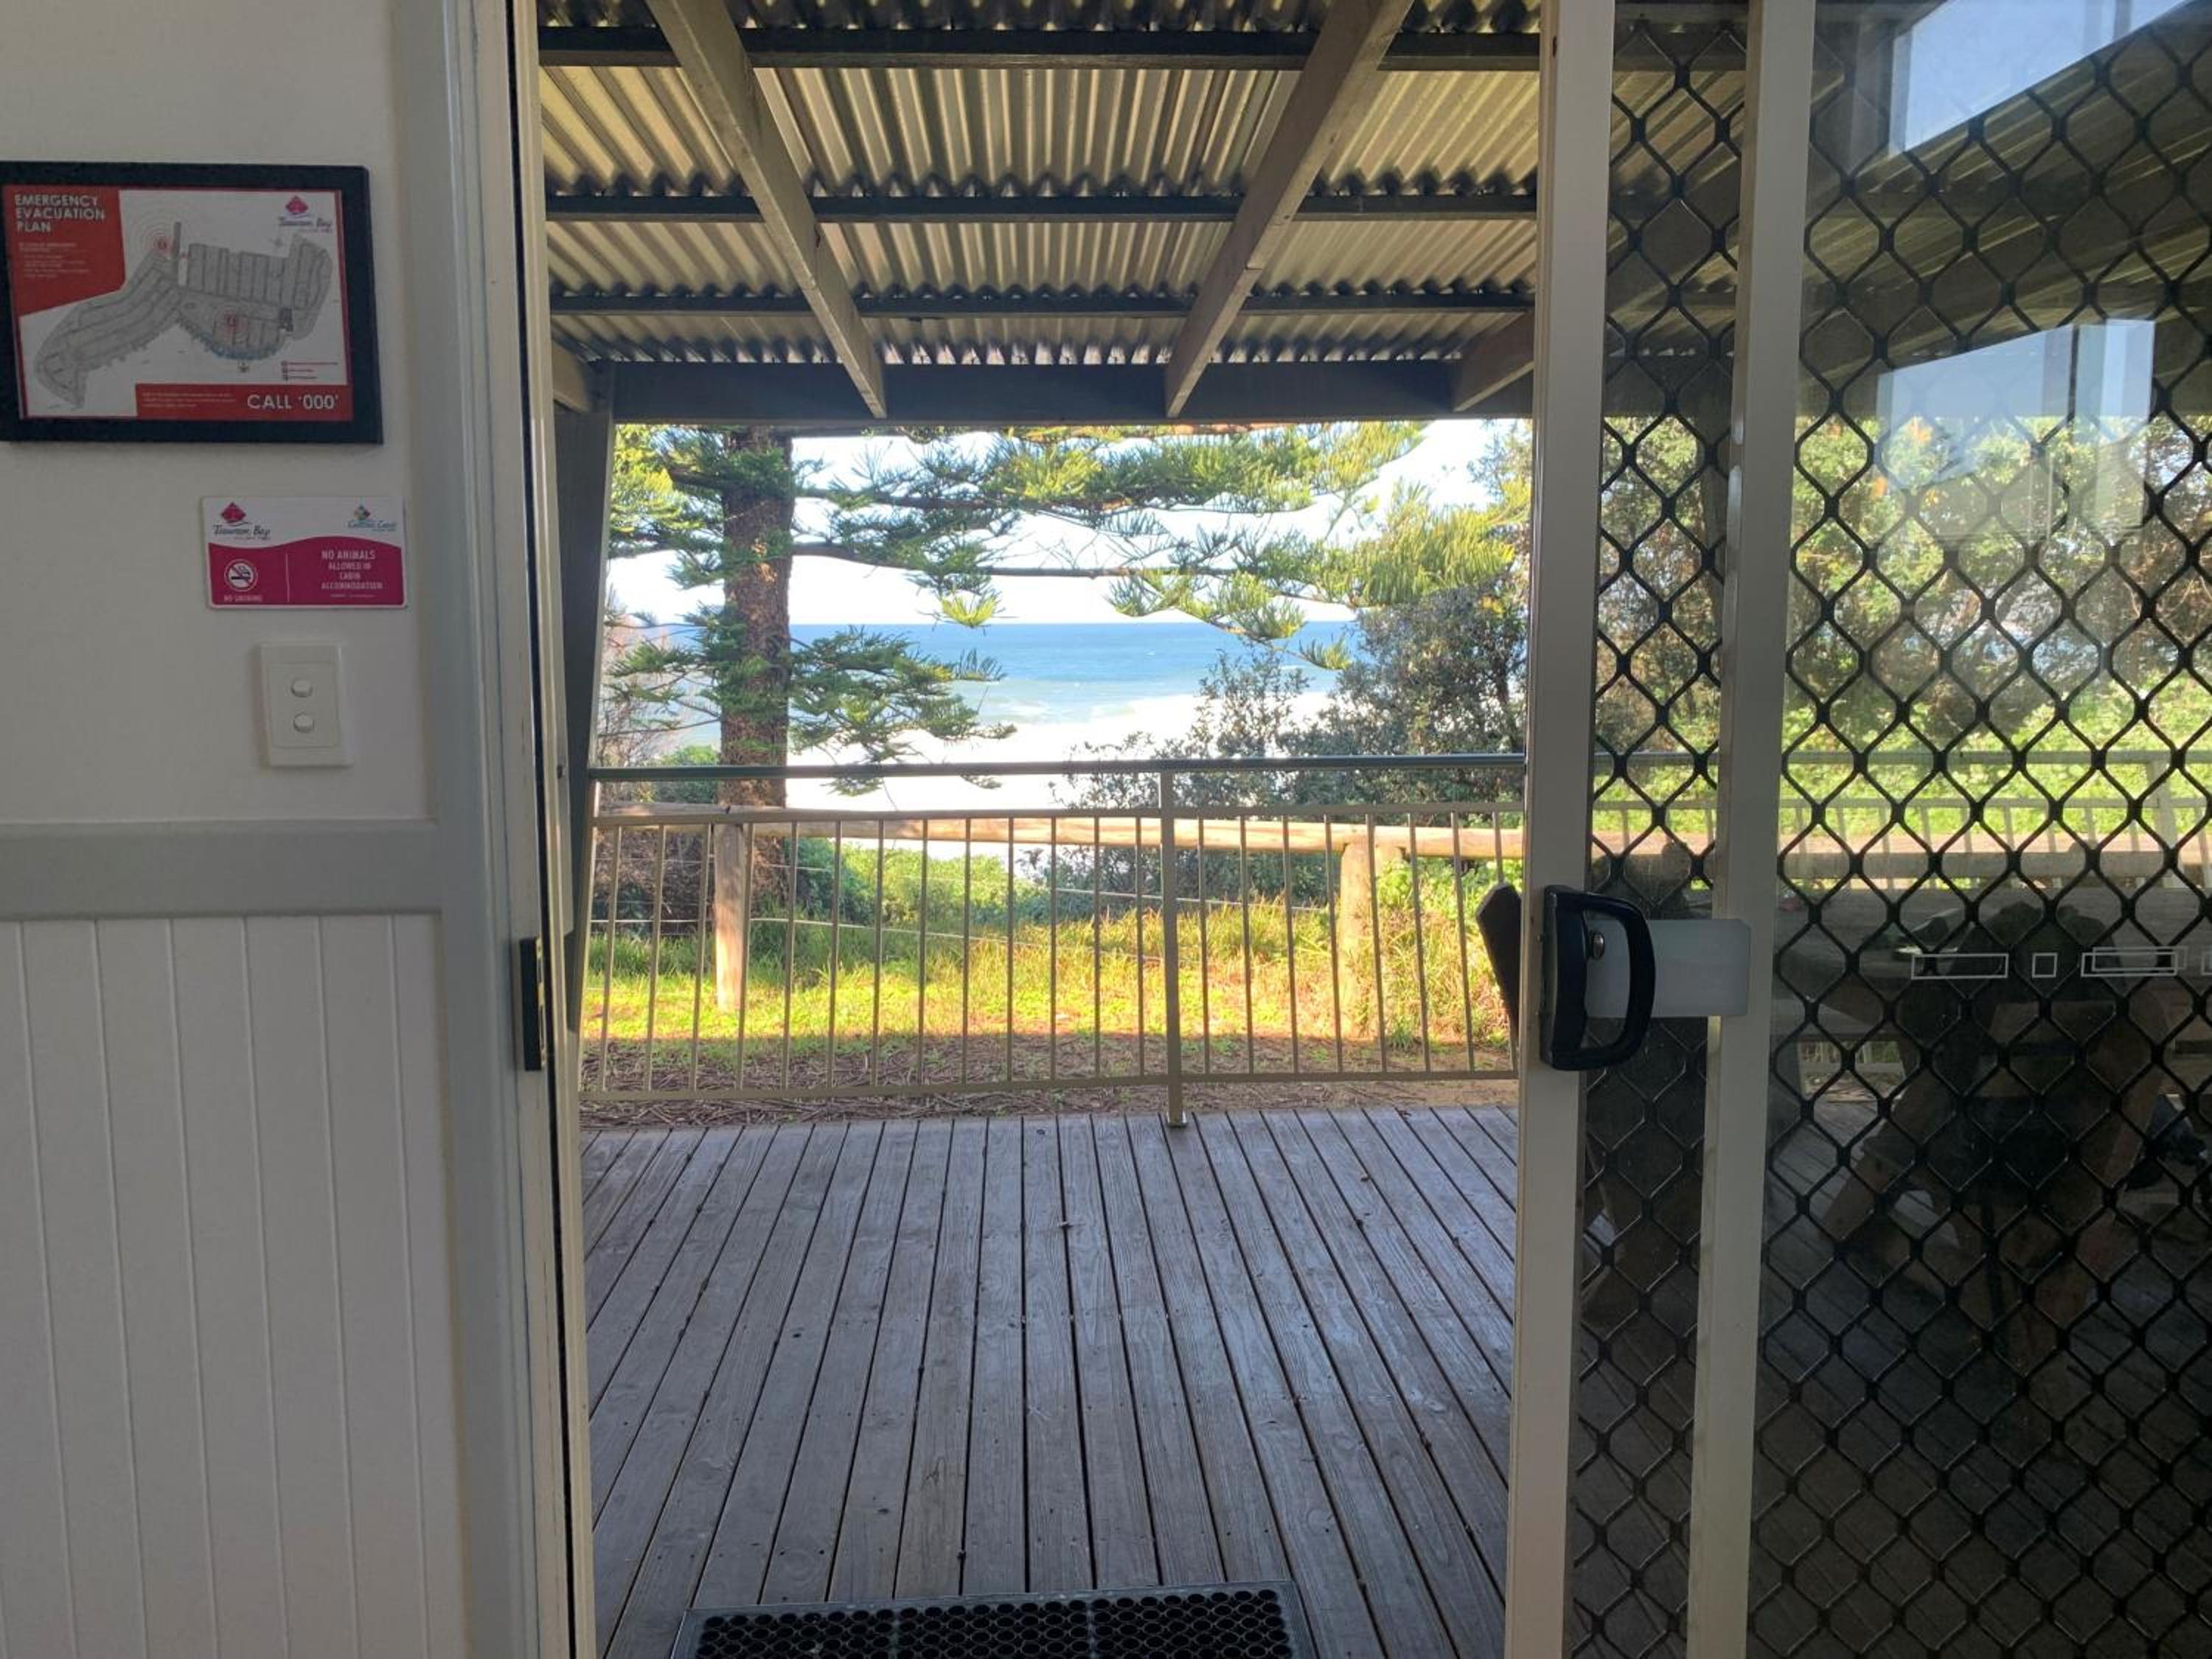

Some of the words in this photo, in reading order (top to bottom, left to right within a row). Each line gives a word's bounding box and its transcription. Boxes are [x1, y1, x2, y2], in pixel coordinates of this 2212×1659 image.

[15, 194, 99, 207] EMERGENCY
[15, 208, 106, 220] EVACUATION
[16, 221, 51, 233] PLAN
[247, 394, 292, 409] CALL
[321, 550, 335, 560] NO
[337, 550, 376, 560] ANIMALS
[328, 562, 361, 571] ALLOWED
[339, 572, 361, 580] CABIN
[321, 582, 383, 590] ACCOMMODATION
